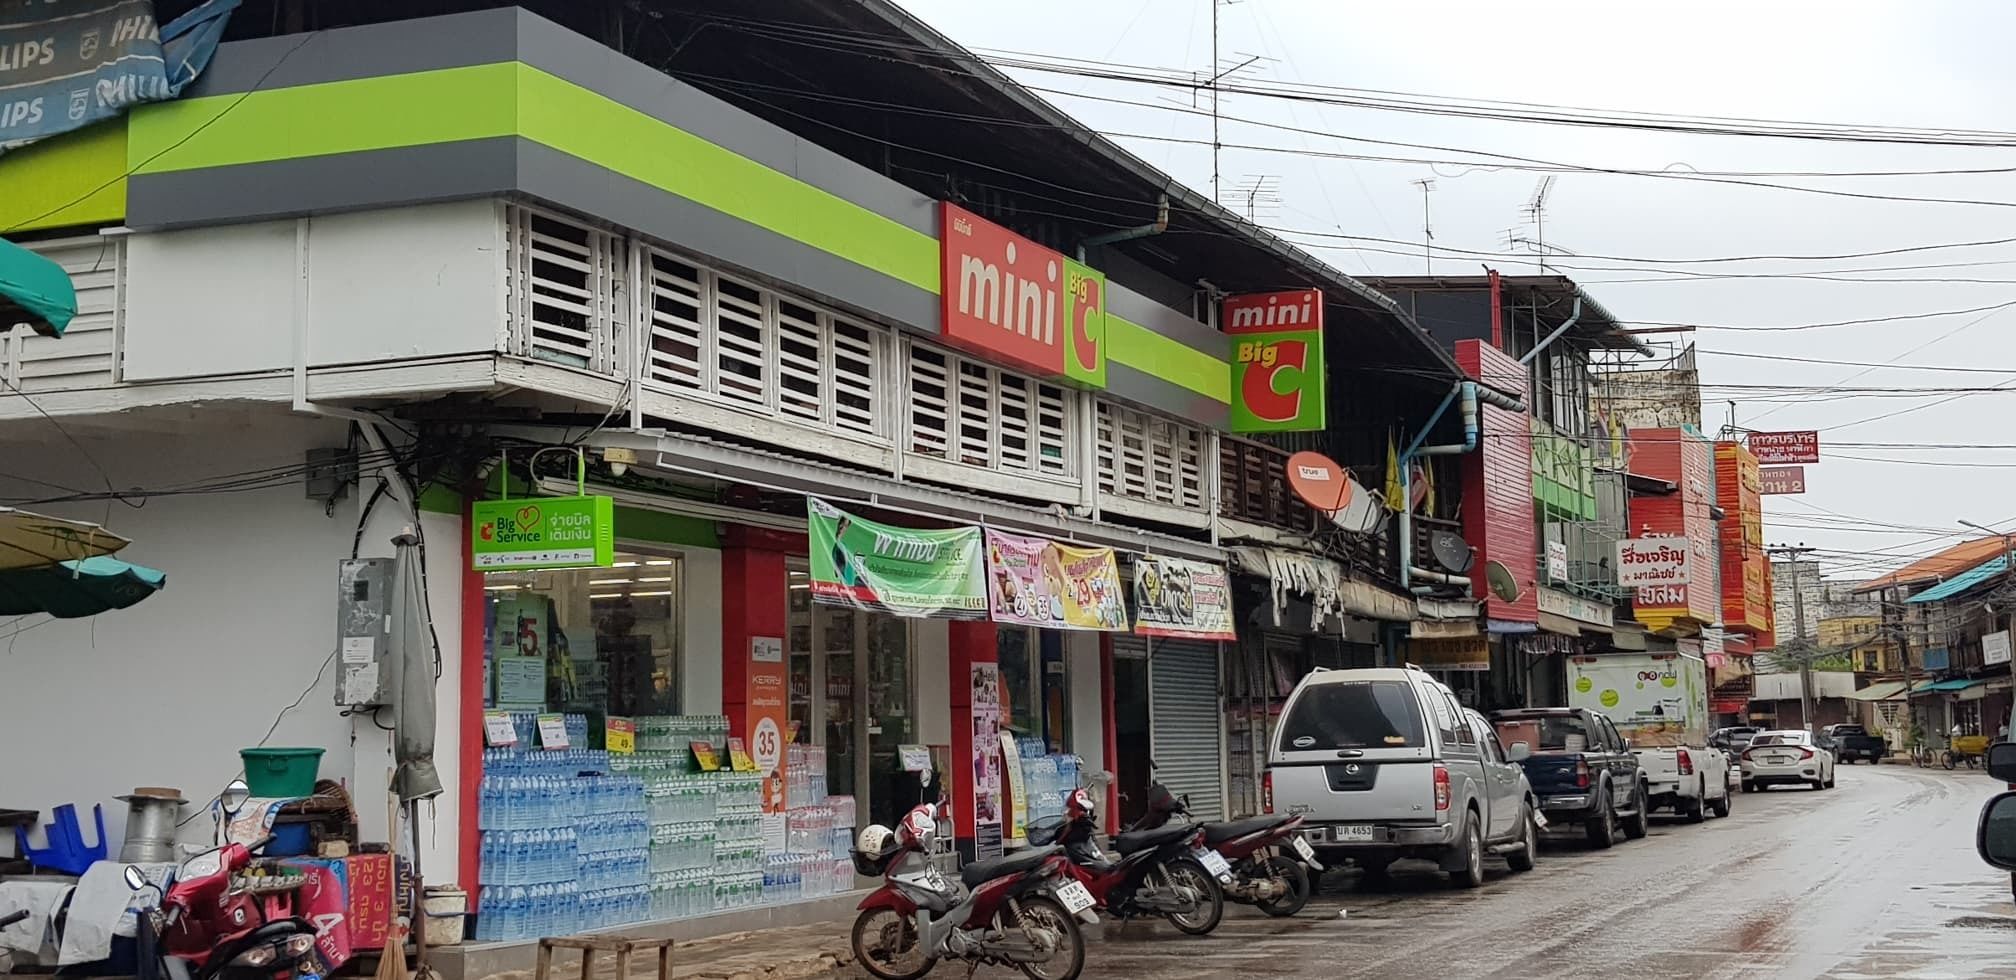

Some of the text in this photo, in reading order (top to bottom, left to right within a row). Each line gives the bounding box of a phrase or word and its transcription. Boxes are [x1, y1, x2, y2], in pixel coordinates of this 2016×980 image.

[959, 241, 1057, 345] mini
[1232, 294, 1313, 328] mini
[1070, 272, 1101, 373] Big C
[1238, 339, 1308, 422] Big C
[1302, 468, 1319, 476] true
[1792, 480, 1802, 492] 2
[497, 517, 516, 533] Big
[550, 512, 591, 527] จ่ายบิล
[497, 531, 541, 543] Service
[550, 527, 591, 541] เติมเงิน
[758, 731, 775, 756] 35
[313, 913, 344, 938] 4
